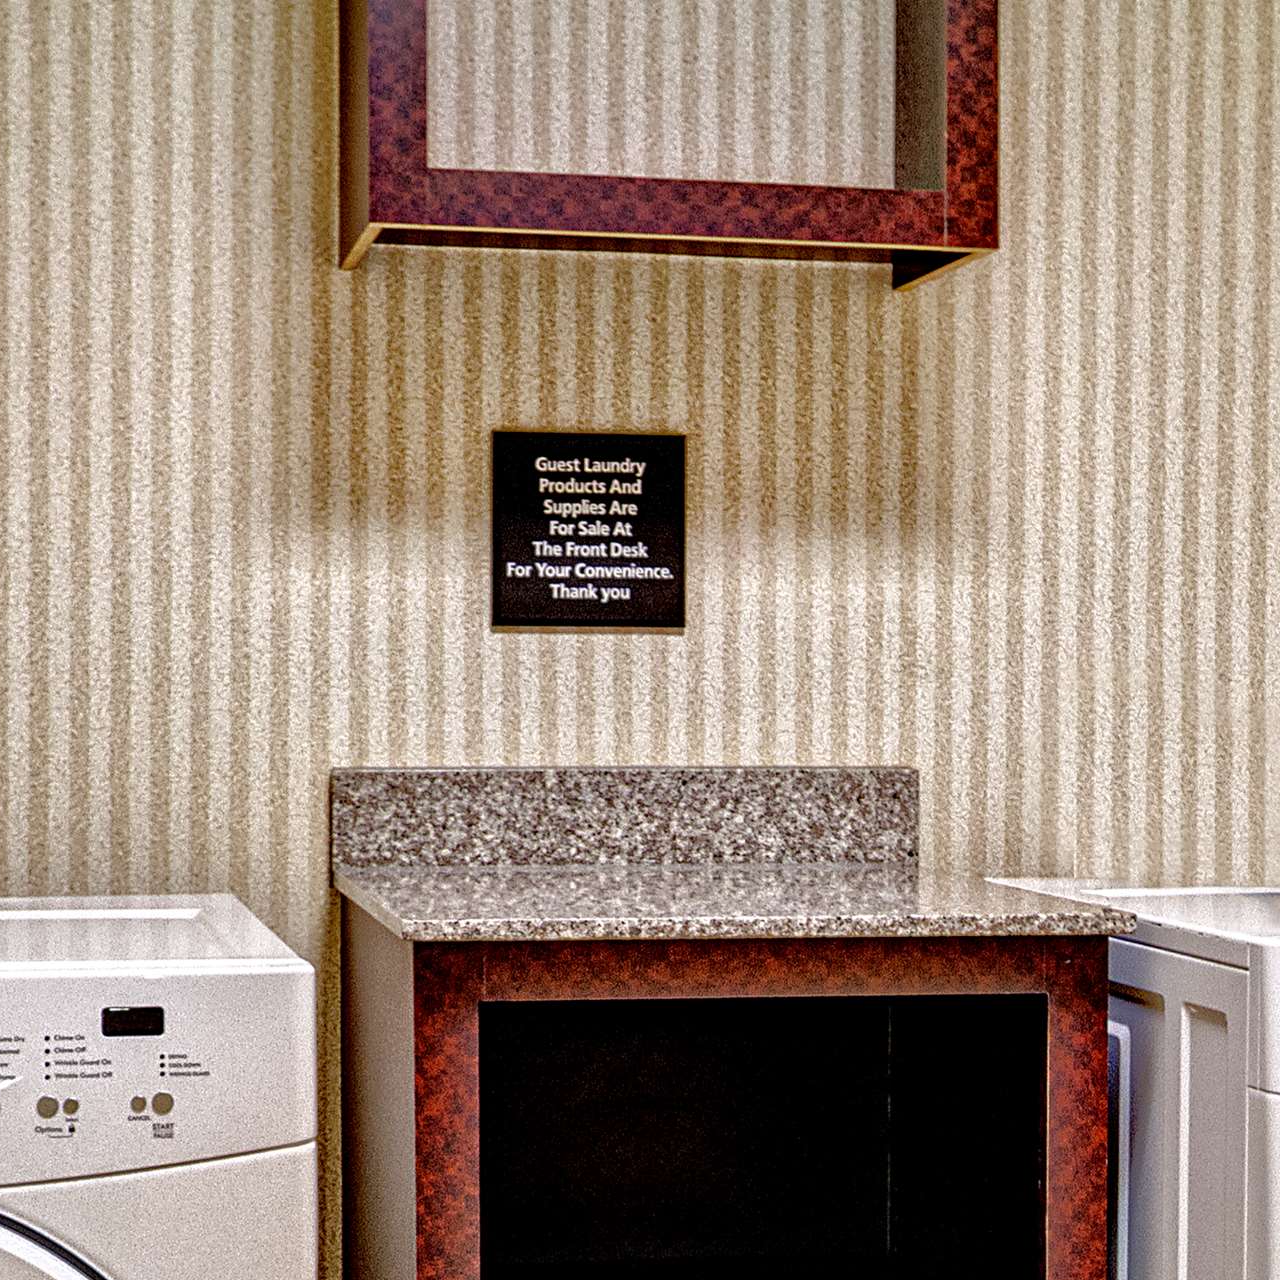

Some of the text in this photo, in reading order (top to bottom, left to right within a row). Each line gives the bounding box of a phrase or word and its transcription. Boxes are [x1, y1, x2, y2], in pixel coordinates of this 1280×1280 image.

[535, 457, 646, 477] Guest Laundry
[539, 478, 642, 494] Products And
[543, 500, 638, 518] Supplies Are
[549, 521, 633, 536] For Sale At
[532, 541, 648, 558] The Front Desk
[506, 563, 674, 579] For Your Convenience.
[550, 584, 631, 603] Thank you
